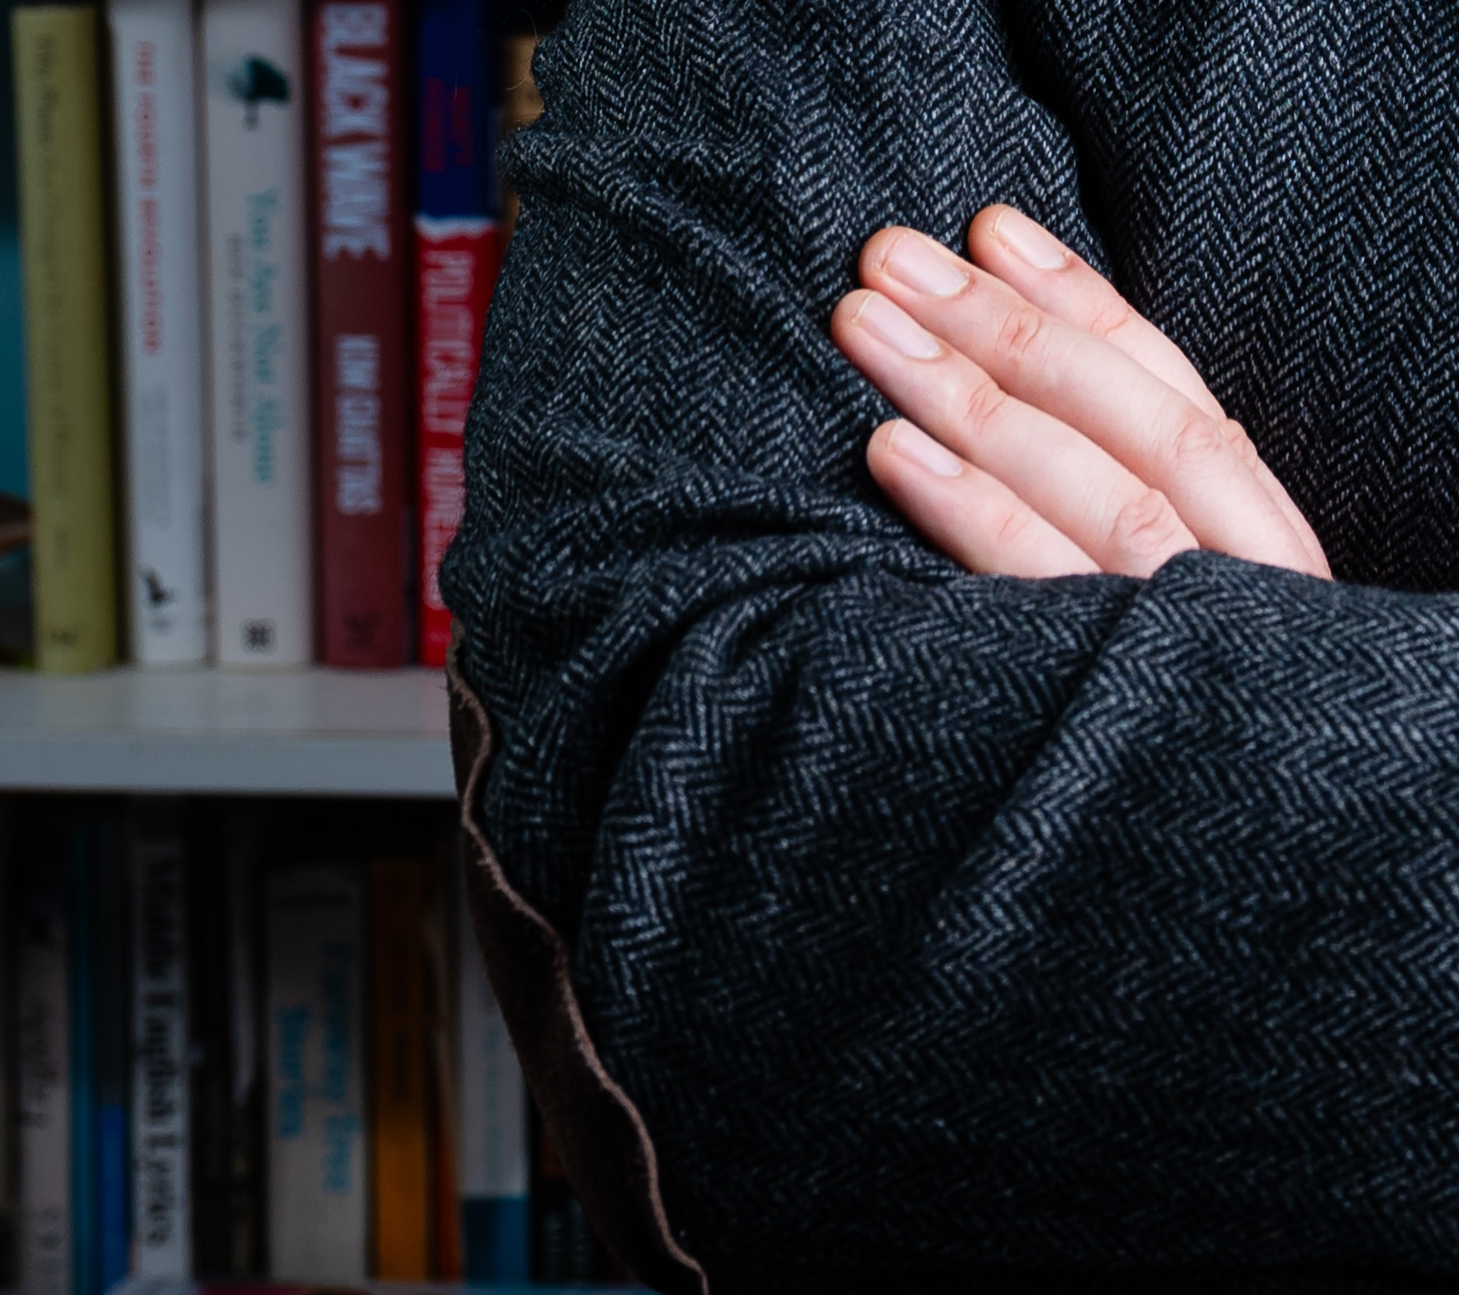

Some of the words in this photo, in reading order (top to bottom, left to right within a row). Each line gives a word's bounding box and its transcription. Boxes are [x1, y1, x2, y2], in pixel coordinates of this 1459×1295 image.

[321, 2, 389, 136] BLACK
[247, 188, 282, 251] You
[320, 139, 392, 262] WAVE
[135, 199, 164, 356] REVOLUTION
[249, 257, 283, 316] Are
[250, 326, 286, 384] Not
[335, 335, 382, 388] KIM
[420, 248, 475, 434] POLITICALLY
[250, 394, 287, 487] Alone
[132, 988, 188, 1124] English
[133, 1136, 185, 1250] Lyrics
